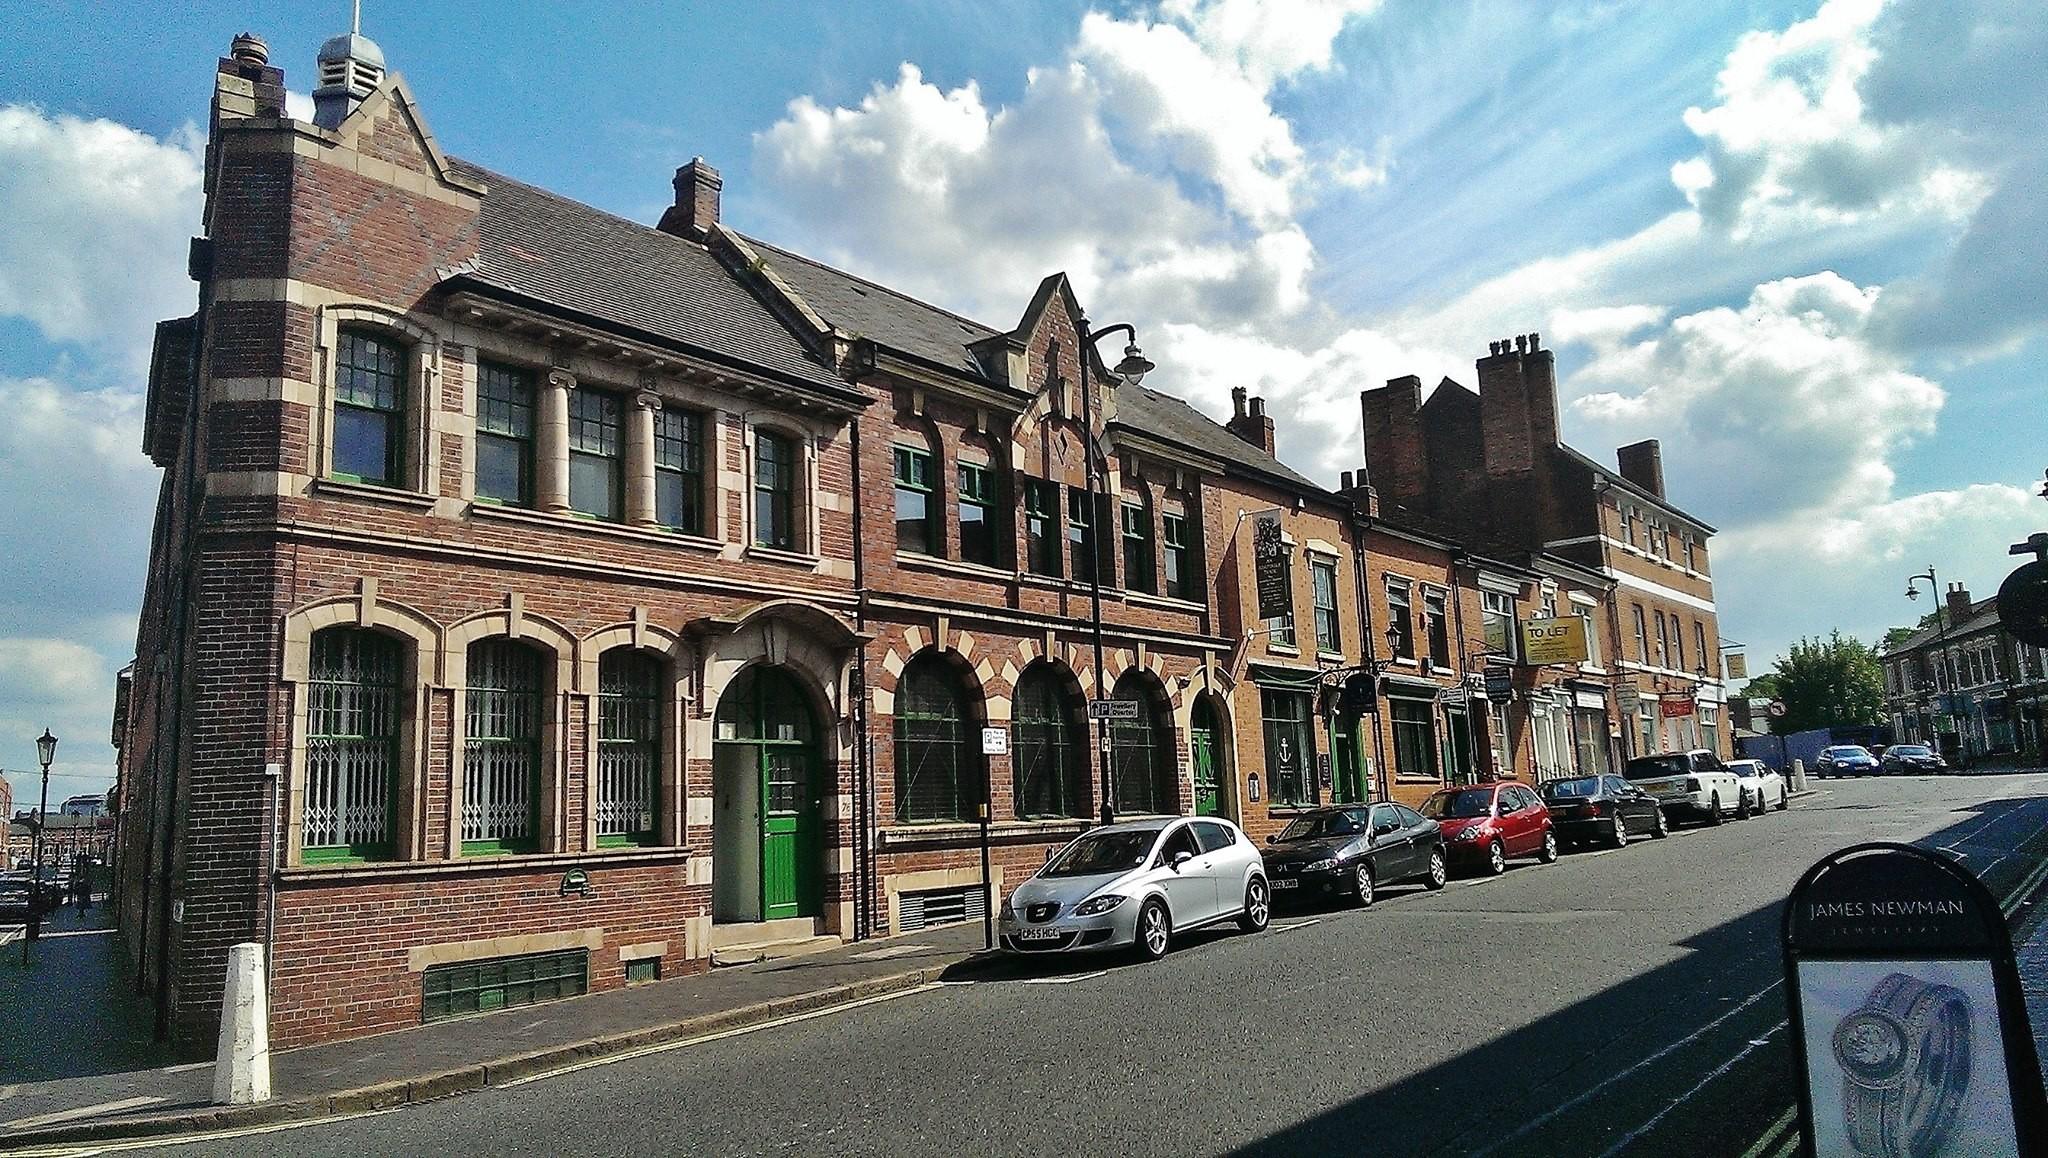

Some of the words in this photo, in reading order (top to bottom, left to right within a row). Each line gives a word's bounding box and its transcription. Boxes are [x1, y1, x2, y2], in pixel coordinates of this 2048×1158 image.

[1527, 628, 1544, 638] TO
[1547, 626, 1570, 637] LET
[1101, 704, 1108, 715] P
[1110, 702, 1137, 711] Jewellery
[1112, 709, 1136, 717] Quarter
[1810, 901, 1865, 921] JAMES
[1871, 900, 1965, 917] NEWMAN
